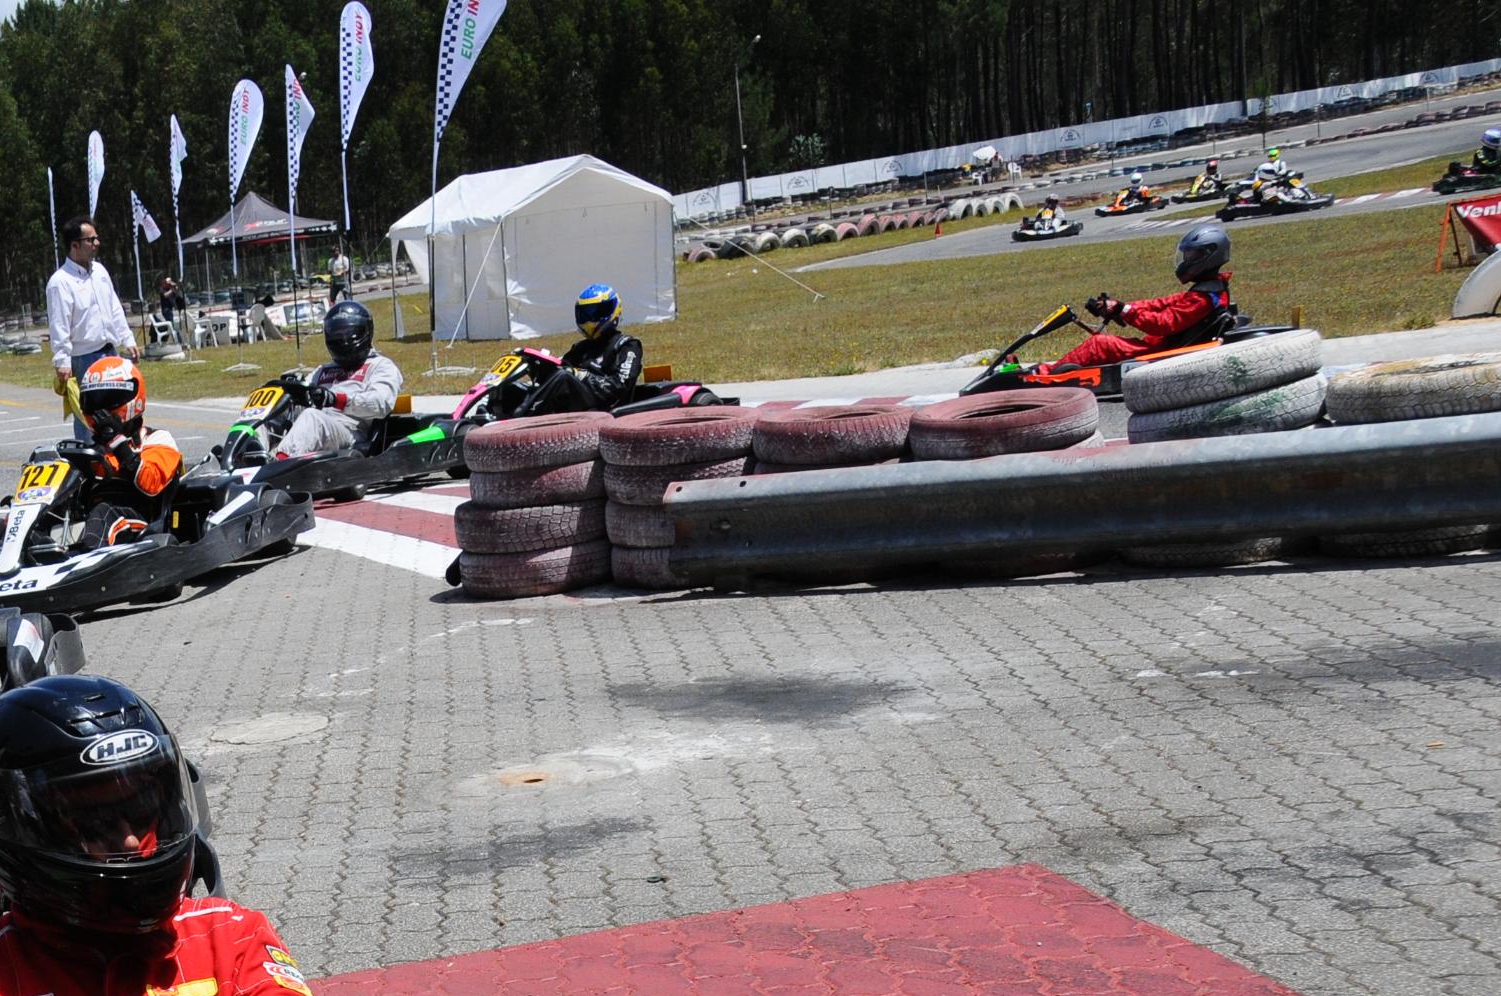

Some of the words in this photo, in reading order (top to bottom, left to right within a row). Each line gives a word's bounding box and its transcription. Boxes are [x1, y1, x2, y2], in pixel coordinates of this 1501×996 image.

[467, 0, 481, 16] IN
[355, 14, 363, 44] INDY
[460, 17, 476, 60] EURO
[242, 87, 250, 114] INDY
[240, 115, 248, 145] EURO
[245, 389, 276, 408] 100
[19, 464, 59, 490] 127
[9, 509, 25, 538] Beta
[97, 734, 147, 760] HJC
